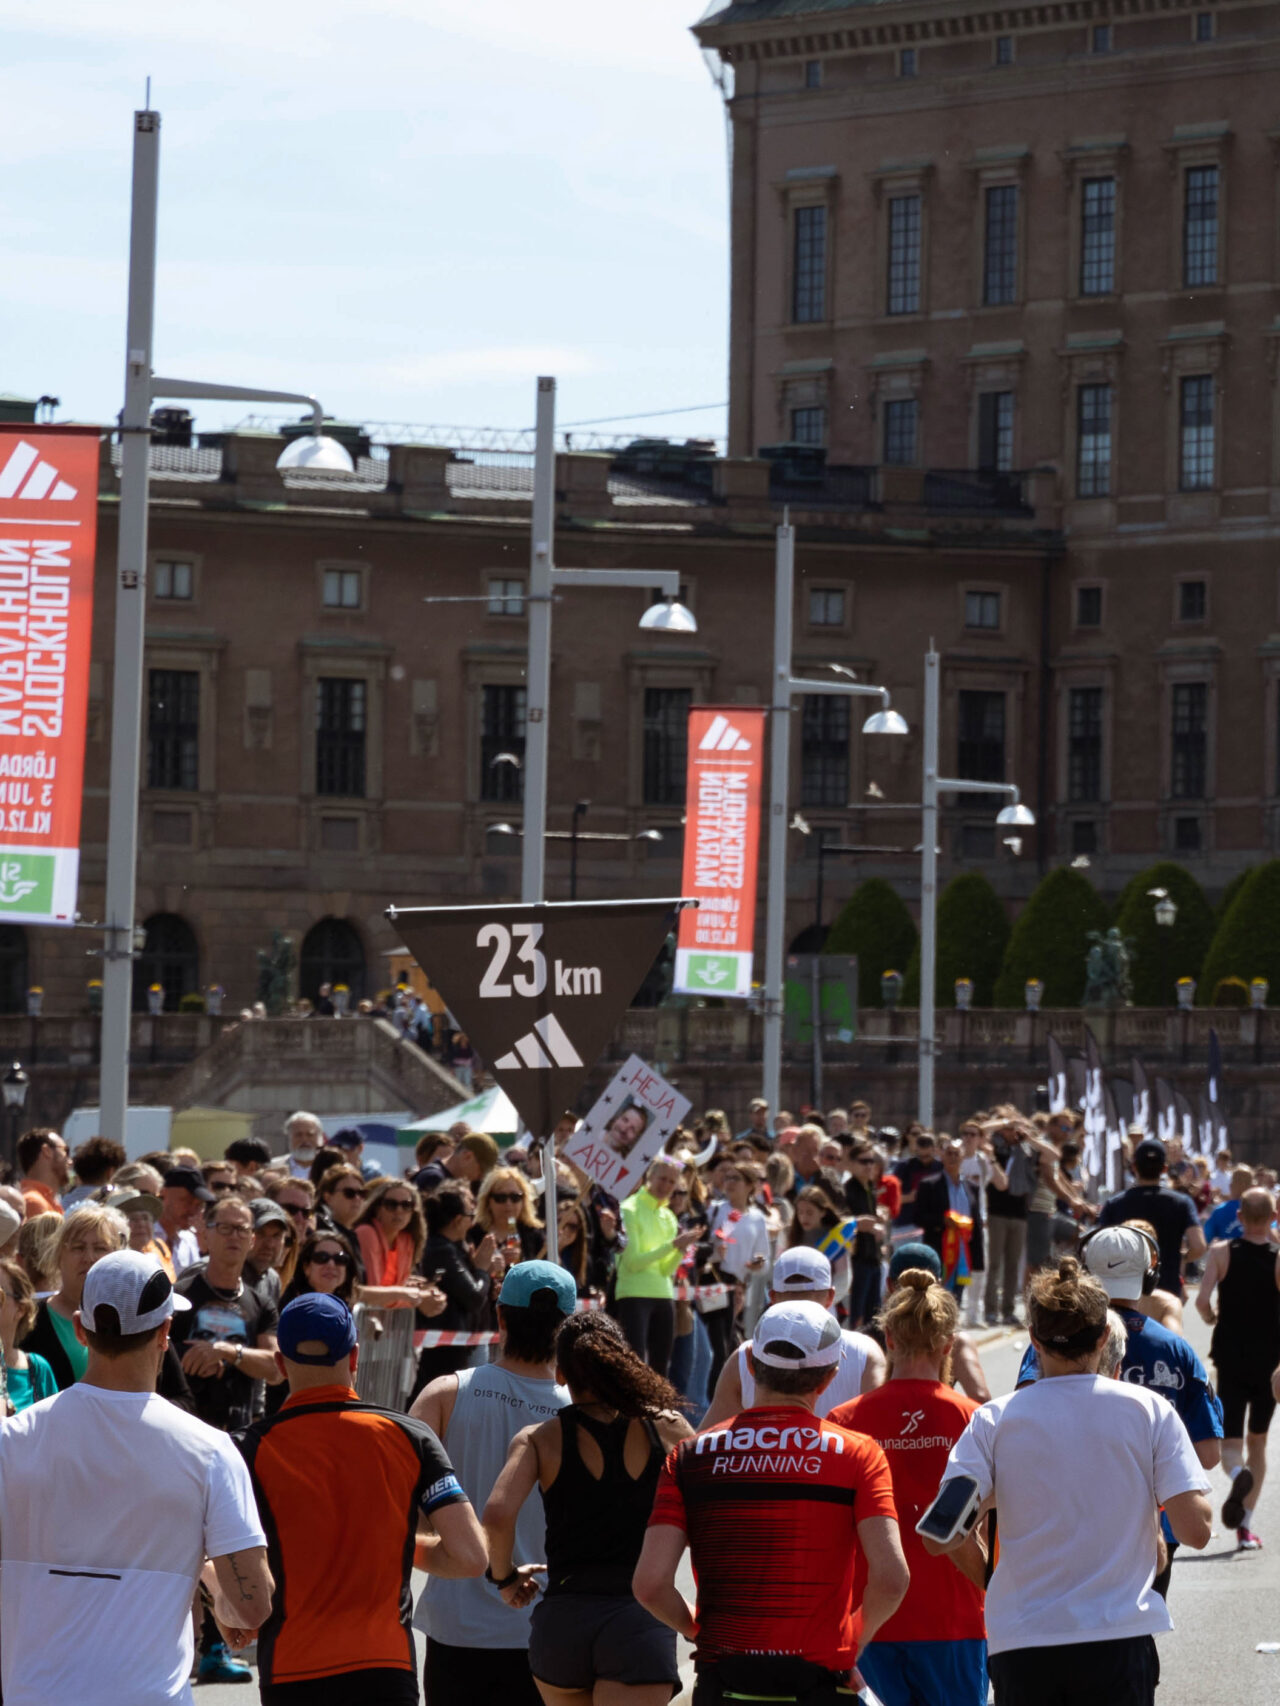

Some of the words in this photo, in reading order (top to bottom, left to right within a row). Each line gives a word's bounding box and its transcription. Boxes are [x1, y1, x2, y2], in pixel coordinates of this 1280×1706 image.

[476, 922, 547, 998] 23
[554, 959, 602, 996] km
[629, 1068, 676, 1119] HEJA
[474, 1388, 524, 1408] DISTRICT
[528, 1403, 559, 1416] VISIO
[695, 1427, 844, 1454] macron
[712, 1455, 823, 1475] RUNNING
